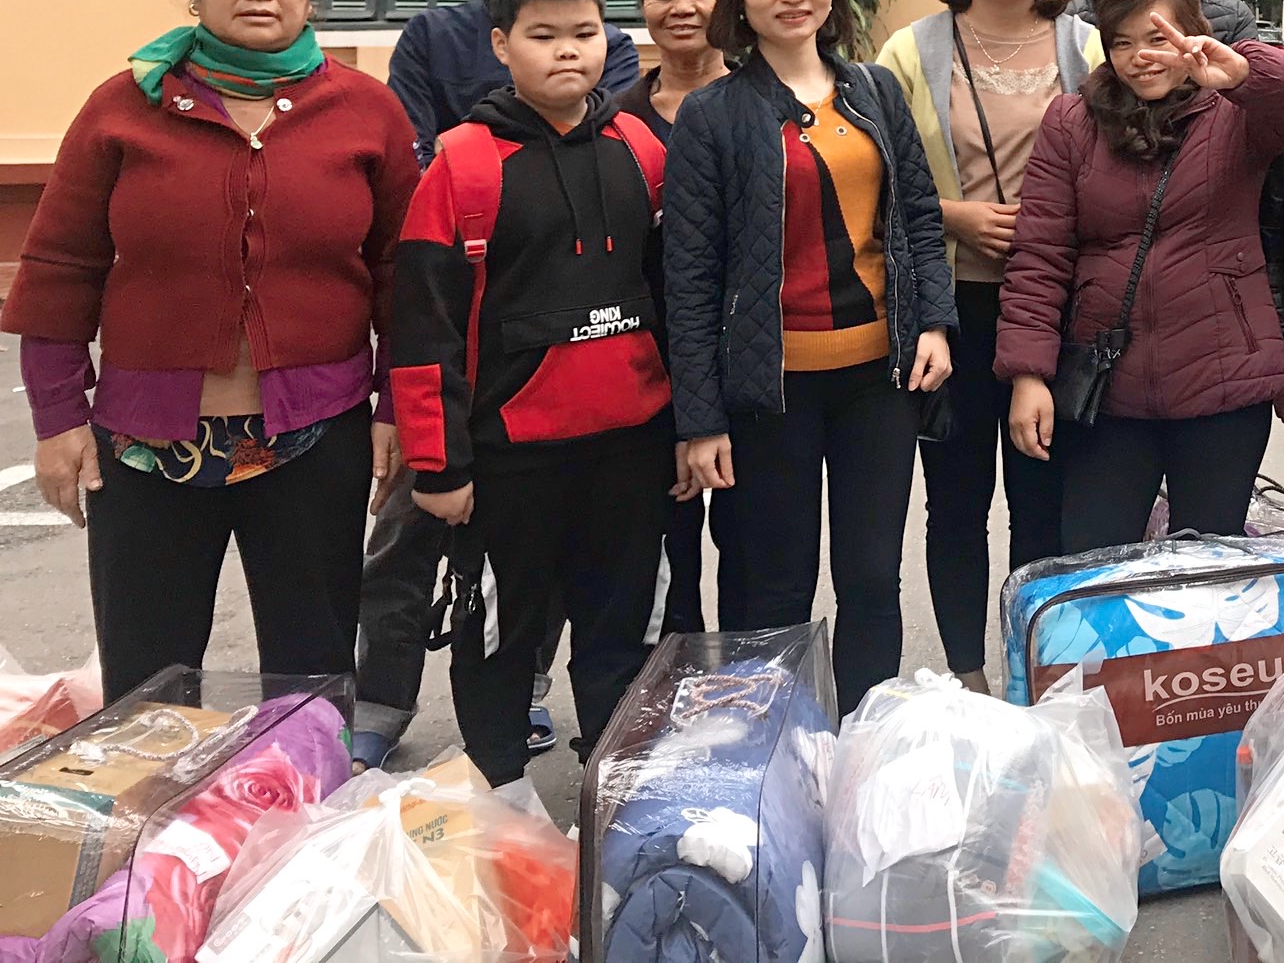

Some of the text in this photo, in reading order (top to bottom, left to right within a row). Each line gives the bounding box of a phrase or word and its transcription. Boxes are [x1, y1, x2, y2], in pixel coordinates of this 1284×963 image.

[589, 305, 621, 325] KING
[1156, 709, 1183, 727] Bốn
[1186, 707, 1215, 723] mùa
[1217, 701, 1242, 720] yêu
